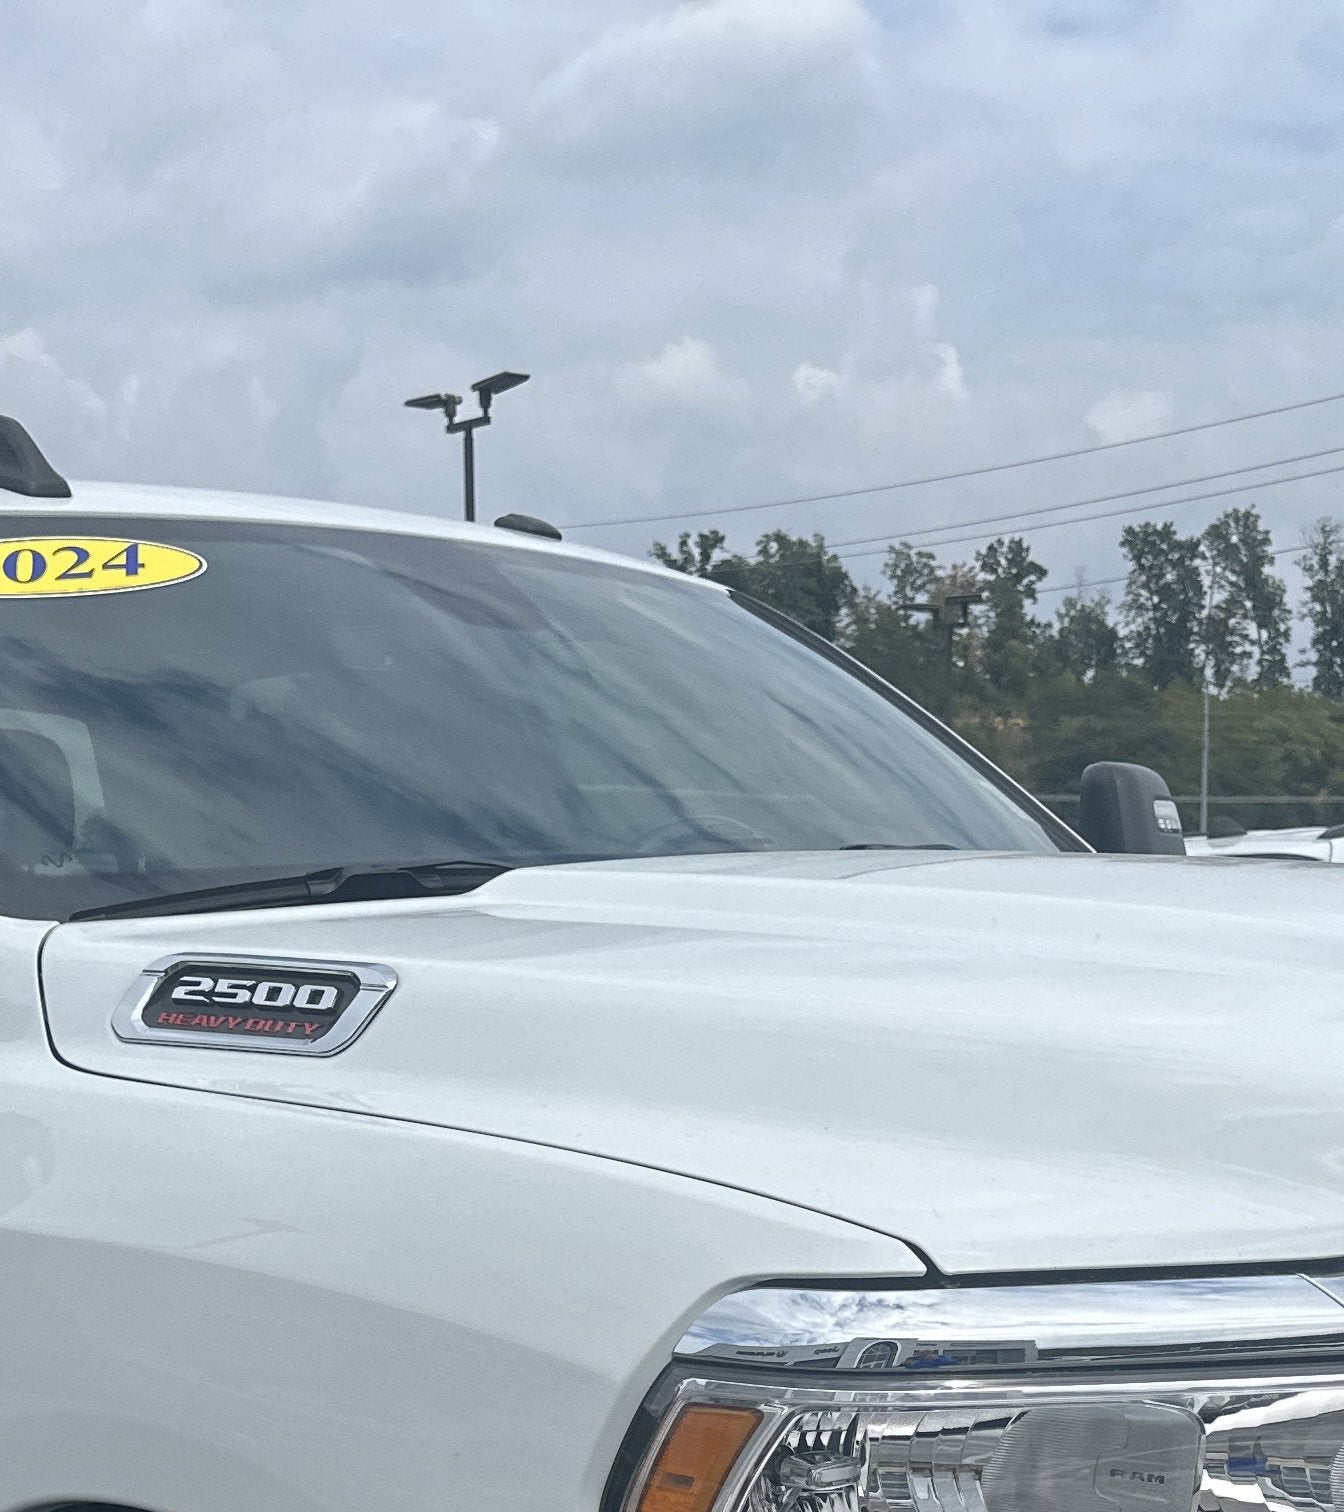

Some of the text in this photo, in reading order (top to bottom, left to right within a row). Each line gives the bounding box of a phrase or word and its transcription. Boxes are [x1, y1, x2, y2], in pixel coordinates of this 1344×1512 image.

[170, 975, 339, 1012] 2500
[156, 1011, 324, 1036] HEAVY DUTY
